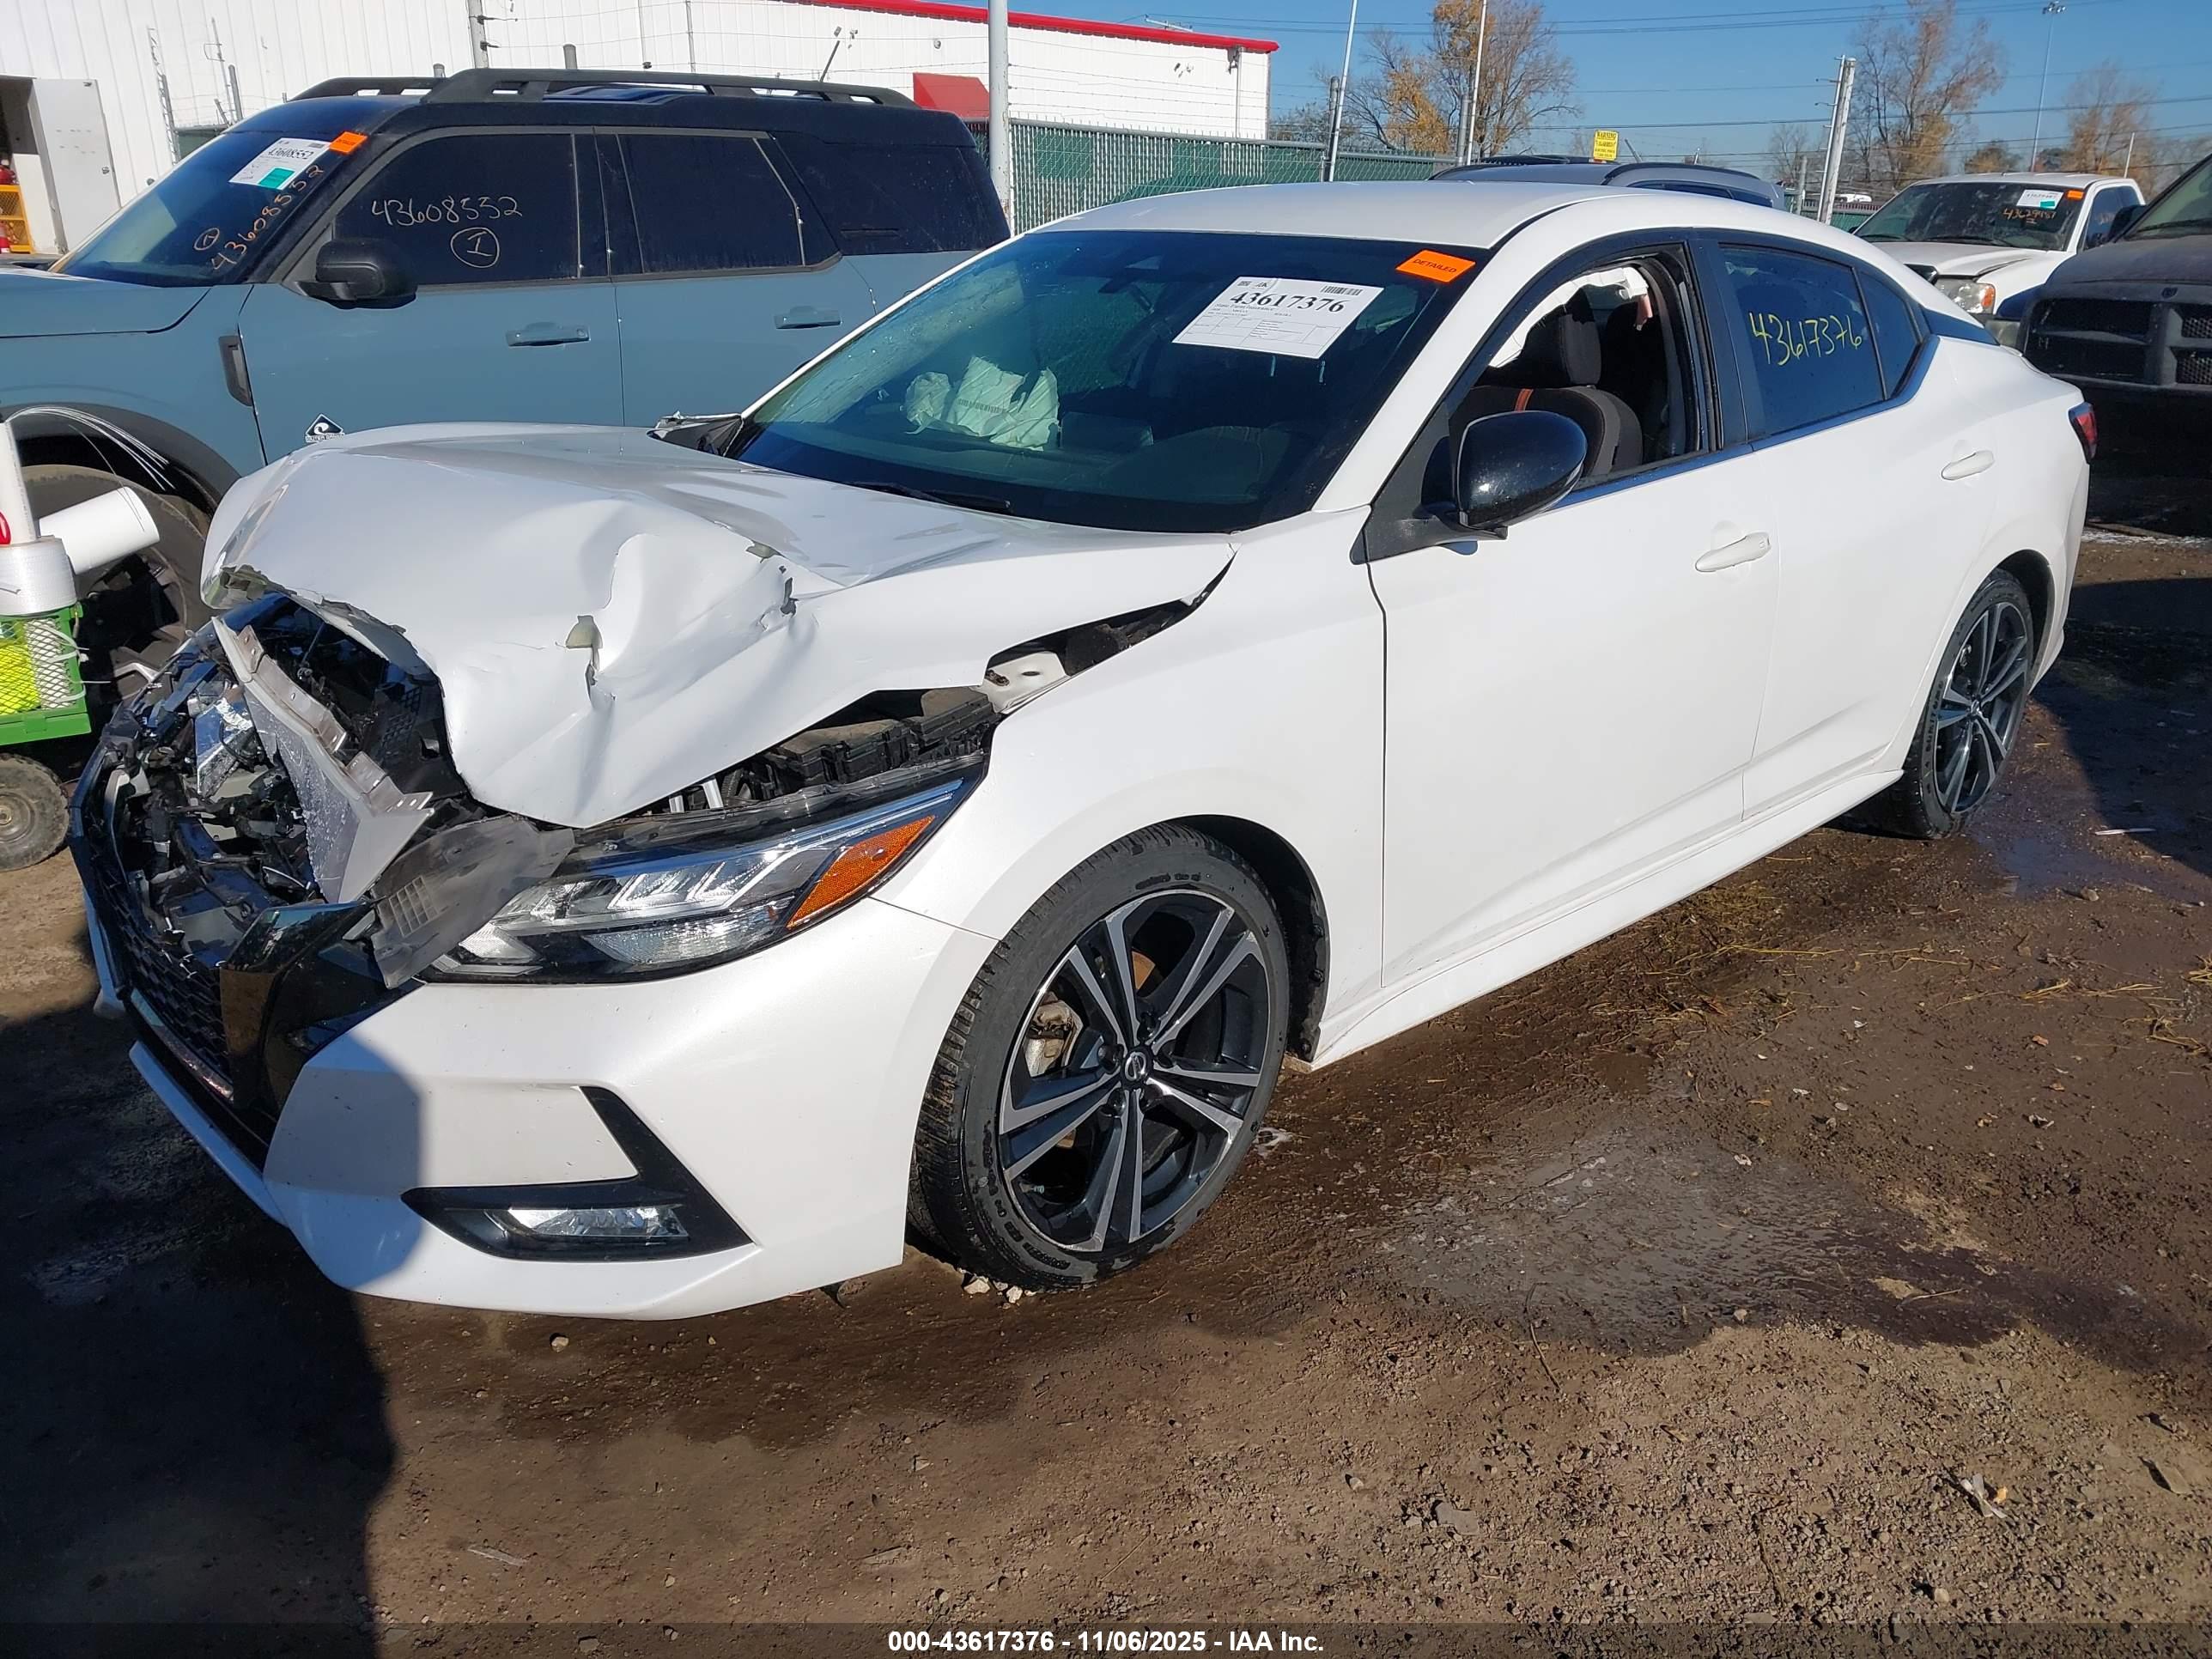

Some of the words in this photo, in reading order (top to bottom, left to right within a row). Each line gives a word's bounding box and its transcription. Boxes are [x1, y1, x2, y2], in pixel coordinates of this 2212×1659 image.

[211, 164, 325, 270] 43608552
[372, 196, 522, 226] 43608552
[1413, 258, 1457, 273] DETAILED
[1230, 292, 1347, 313] 43617376
[1749, 313, 1863, 366] 43617376
